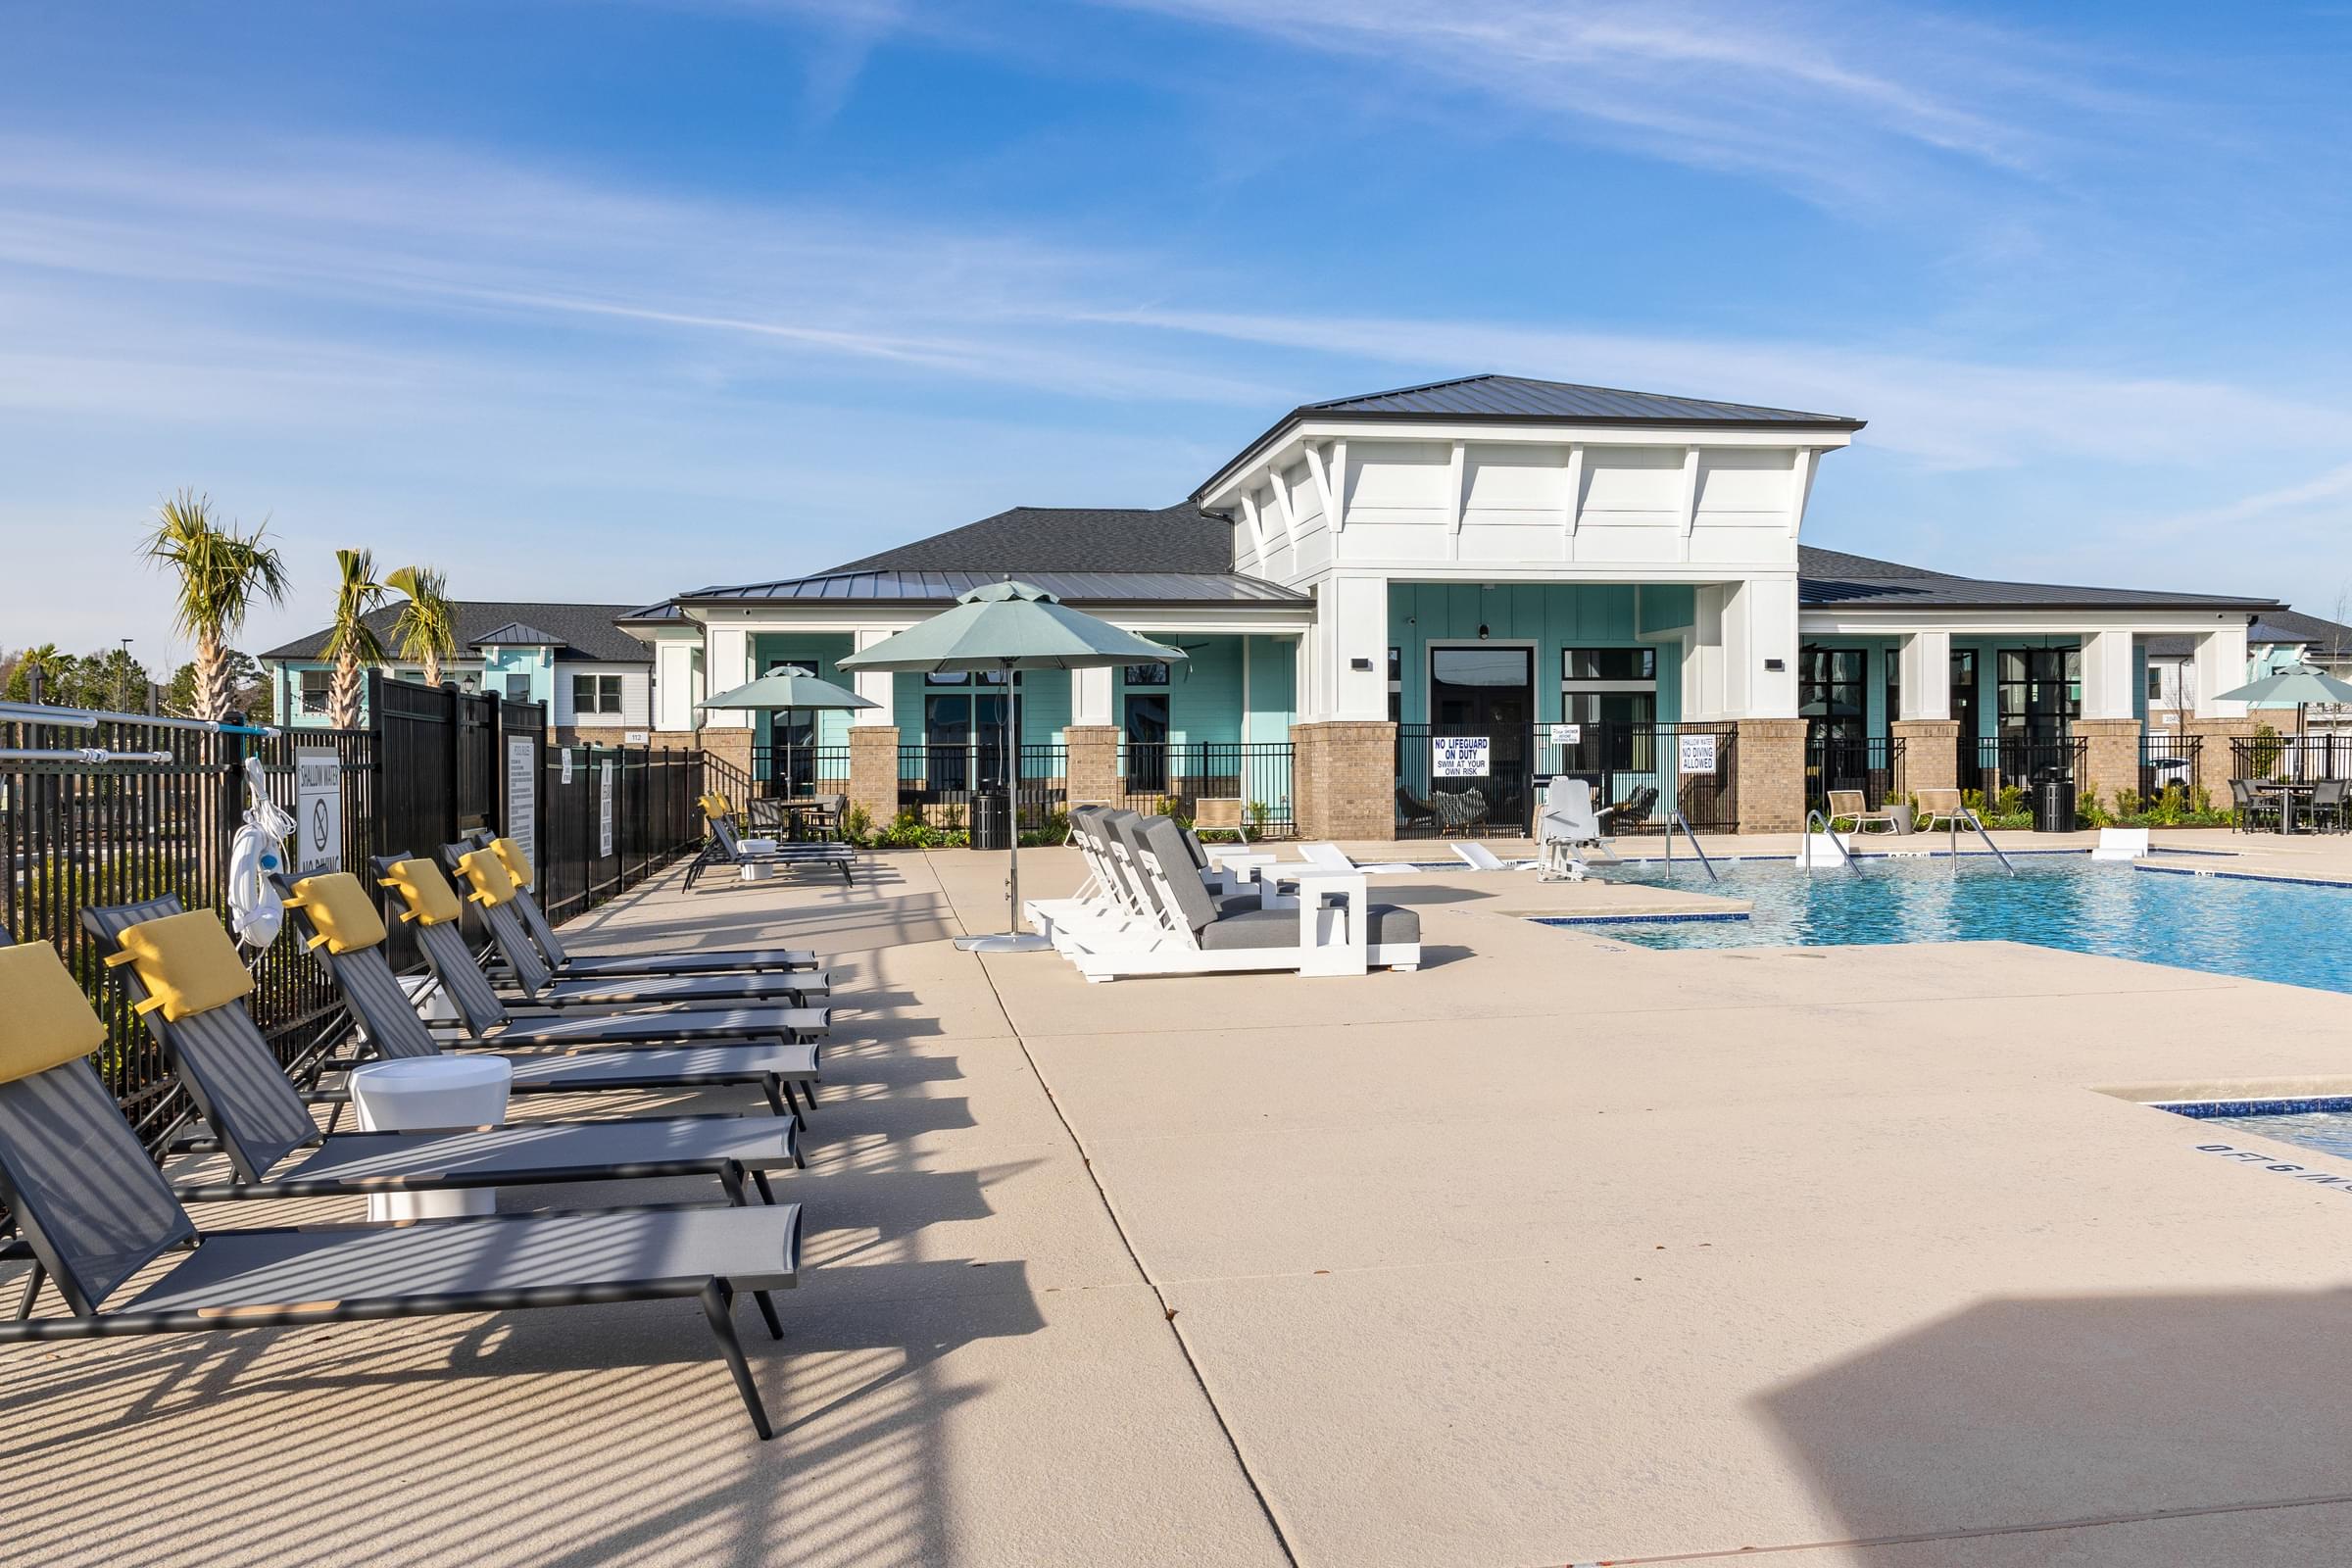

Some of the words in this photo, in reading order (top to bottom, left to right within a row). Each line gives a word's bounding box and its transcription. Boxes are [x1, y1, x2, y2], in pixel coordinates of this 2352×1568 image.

[1435, 738, 1446, 749] NO
[1448, 738, 1488, 749] LIFEGUARD
[1445, 750, 1455, 760] ON
[1458, 749, 1478, 760] DUTY
[1683, 747, 1691, 758] NO
[1692, 747, 1713, 758] DIVING
[1684, 759, 1713, 768] ALLOWED
[301, 764, 323, 787] SHALLOW
[323, 763, 339, 786] WATER
[2221, 1152, 2277, 1163] FT
